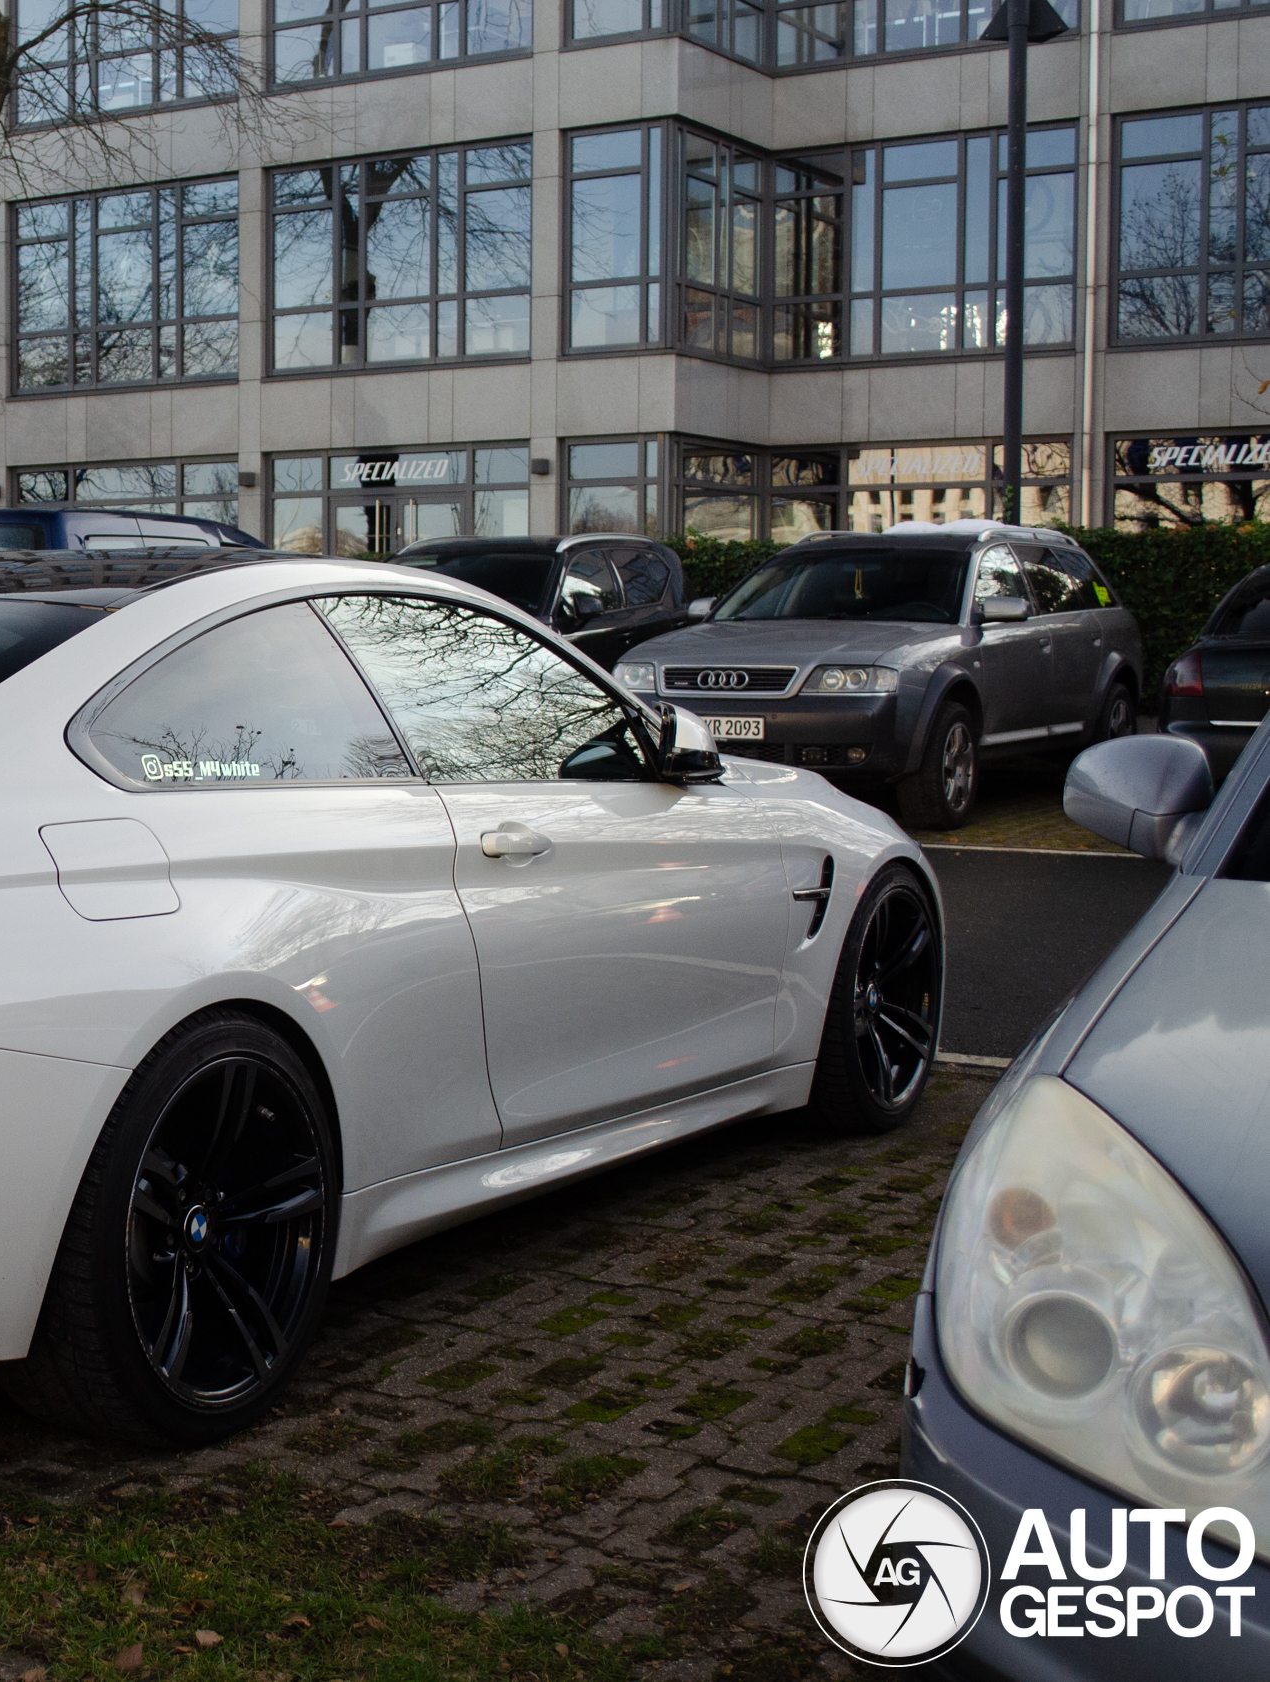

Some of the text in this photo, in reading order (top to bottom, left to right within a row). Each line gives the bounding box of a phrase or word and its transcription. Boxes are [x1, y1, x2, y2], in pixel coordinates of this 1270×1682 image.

[340, 459, 450, 482] SPECIALIZED
[857, 453, 981, 477] SPECIALIZED
[725, 720, 761, 737] 2093
